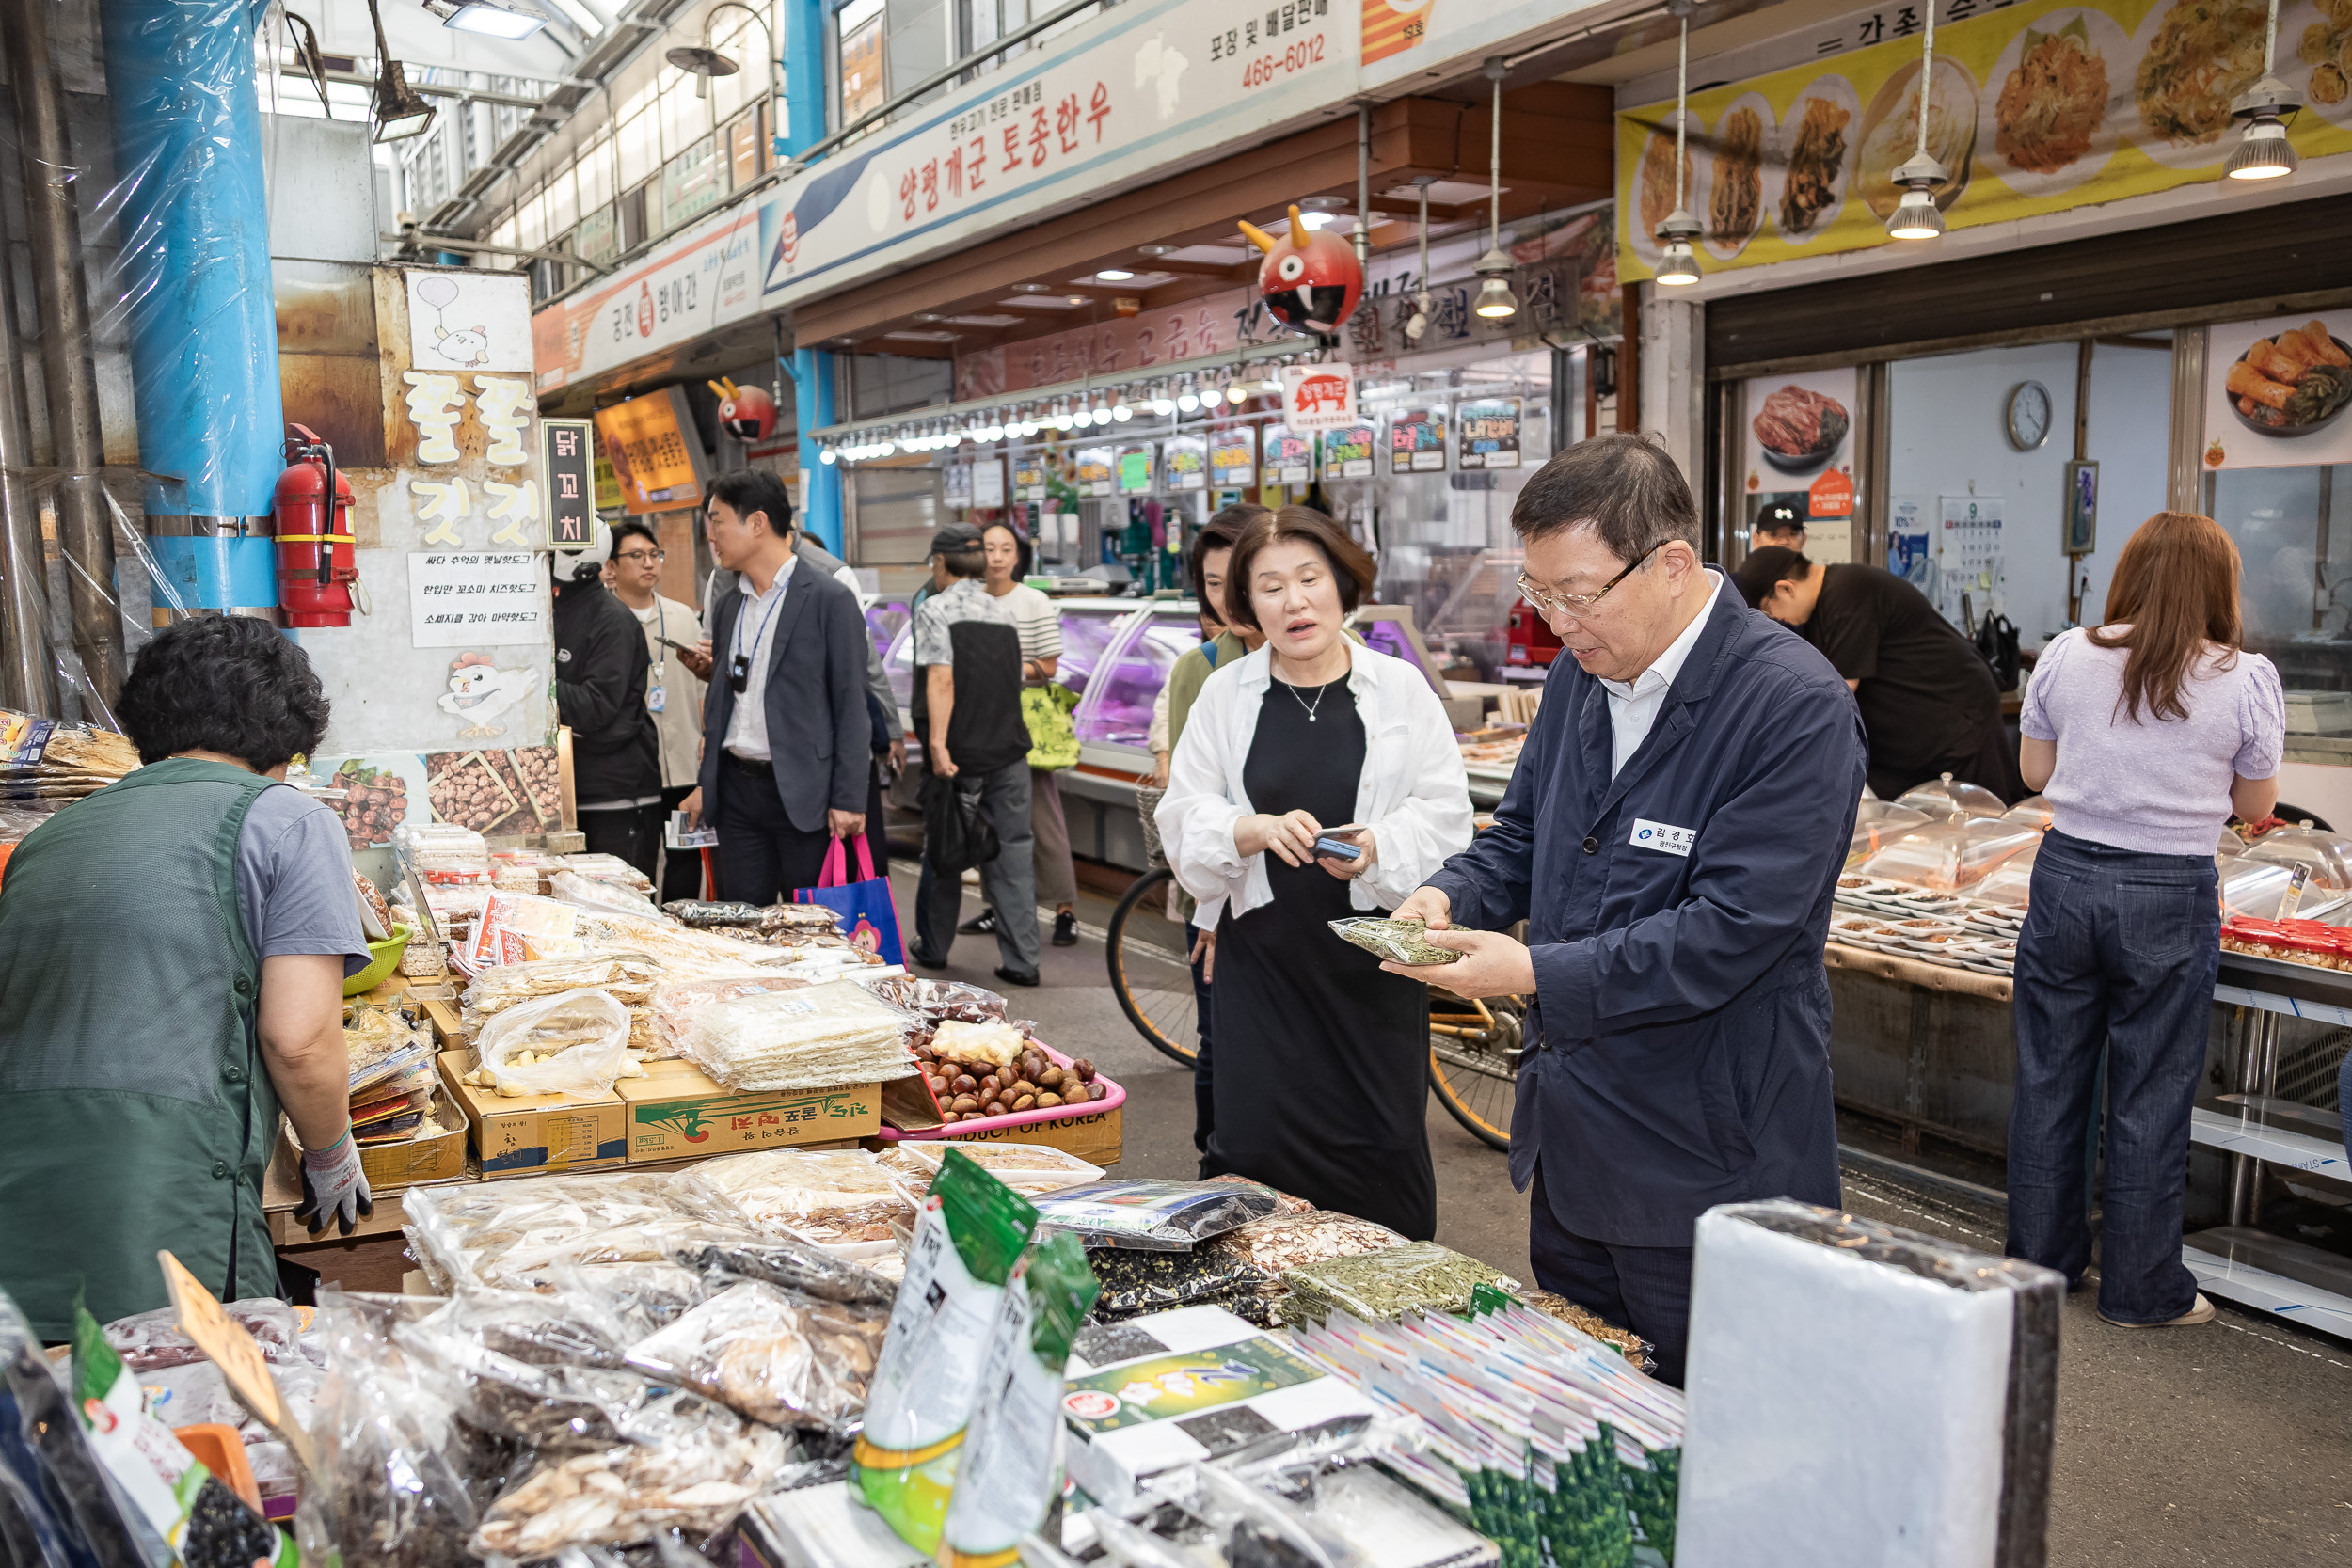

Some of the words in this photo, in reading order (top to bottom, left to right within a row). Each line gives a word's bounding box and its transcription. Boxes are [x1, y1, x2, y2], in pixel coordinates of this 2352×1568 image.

[1210, 26, 1239, 62] 포장
[1245, 18, 1259, 48] 및
[1241, 33, 1325, 88] 466-6012
[899, 135, 987, 222] 양평개군
[1001, 80, 1112, 173] 토종한우
[556, 430, 581, 541] 닭꼬치
[1968, 502, 1978, 518] 9
[426, 555, 446, 564] 싸다
[450, 555, 478, 564] 추억의
[484, 555, 531, 564] 옛날핫도그
[423, 585, 453, 594] 한입만
[456, 585, 485, 594] 꼬소미
[489, 583, 536, 594] 치즈핫도그
[469, 613, 487, 623] 감아
[491, 612, 537, 622] 마약핫도그
[1659, 840, 1688, 852] 광진구청장
[783, 1106, 818, 1123] 굴포
[829, 1101, 869, 1118] 진도
[730, 1111, 780, 1131] 멸치
[1019, 1122, 1043, 1135] OF
[1048, 1112, 1107, 1131] KOREA
[638, 1136, 662, 1145] 1.5kg
[741, 1131, 757, 1141] 왕
[762, 1126, 800, 1139] 칼슘의
